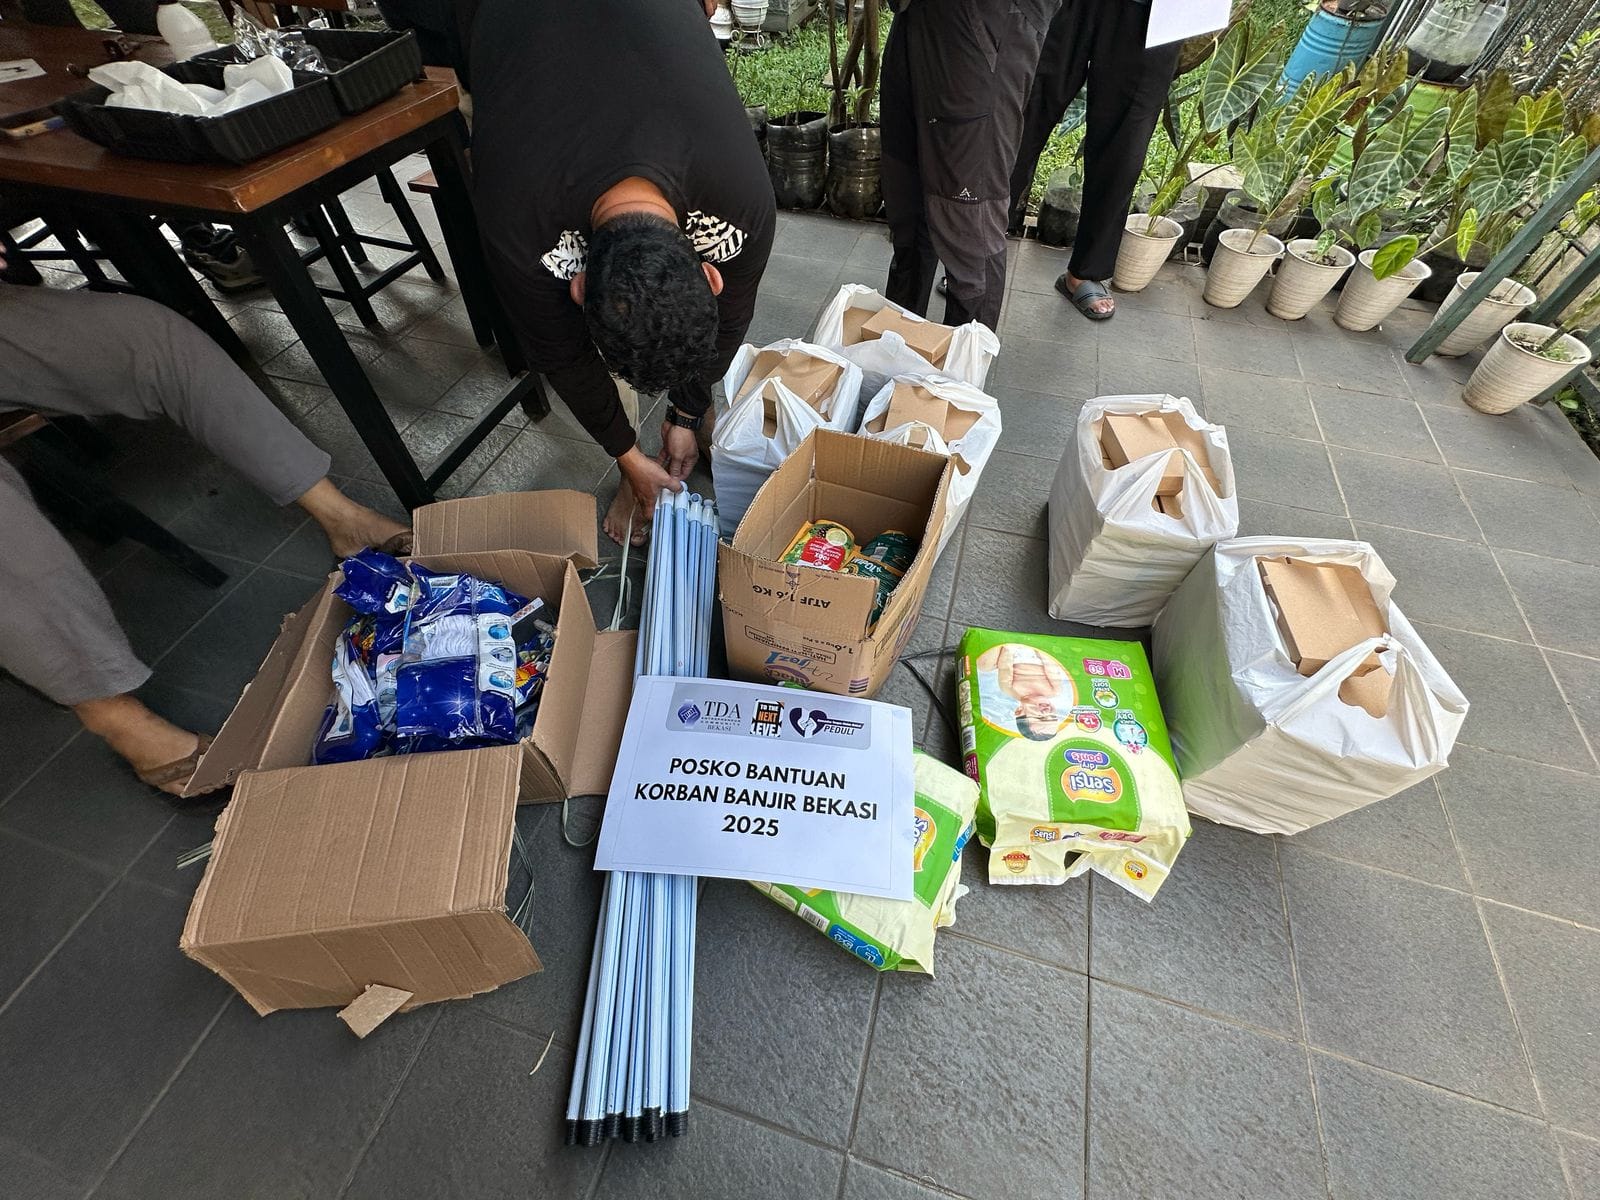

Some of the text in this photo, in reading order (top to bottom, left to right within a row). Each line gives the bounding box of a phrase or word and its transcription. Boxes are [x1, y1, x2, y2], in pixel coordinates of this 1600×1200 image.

[752, 584, 831, 609] ATJF 1,6 KG
[1113, 667, 1125, 677] M
[704, 700, 741, 719] TDA
[758, 710, 778, 723] NEXT
[1083, 717, 1096, 725] 12
[707, 724, 732, 732] BEKASI
[823, 725, 855, 736] PEDULI
[1070, 751, 1103, 764] pants
[1081, 761, 1097, 771] dry
[669, 757, 846, 790] POSKO BANTUAN
[1069, 771, 1115, 794] Sensi
[634, 782, 878, 820] KORBAN BANJIR BEKASI
[721, 814, 780, 837] 2025
[1033, 828, 1057, 841] Sensi
